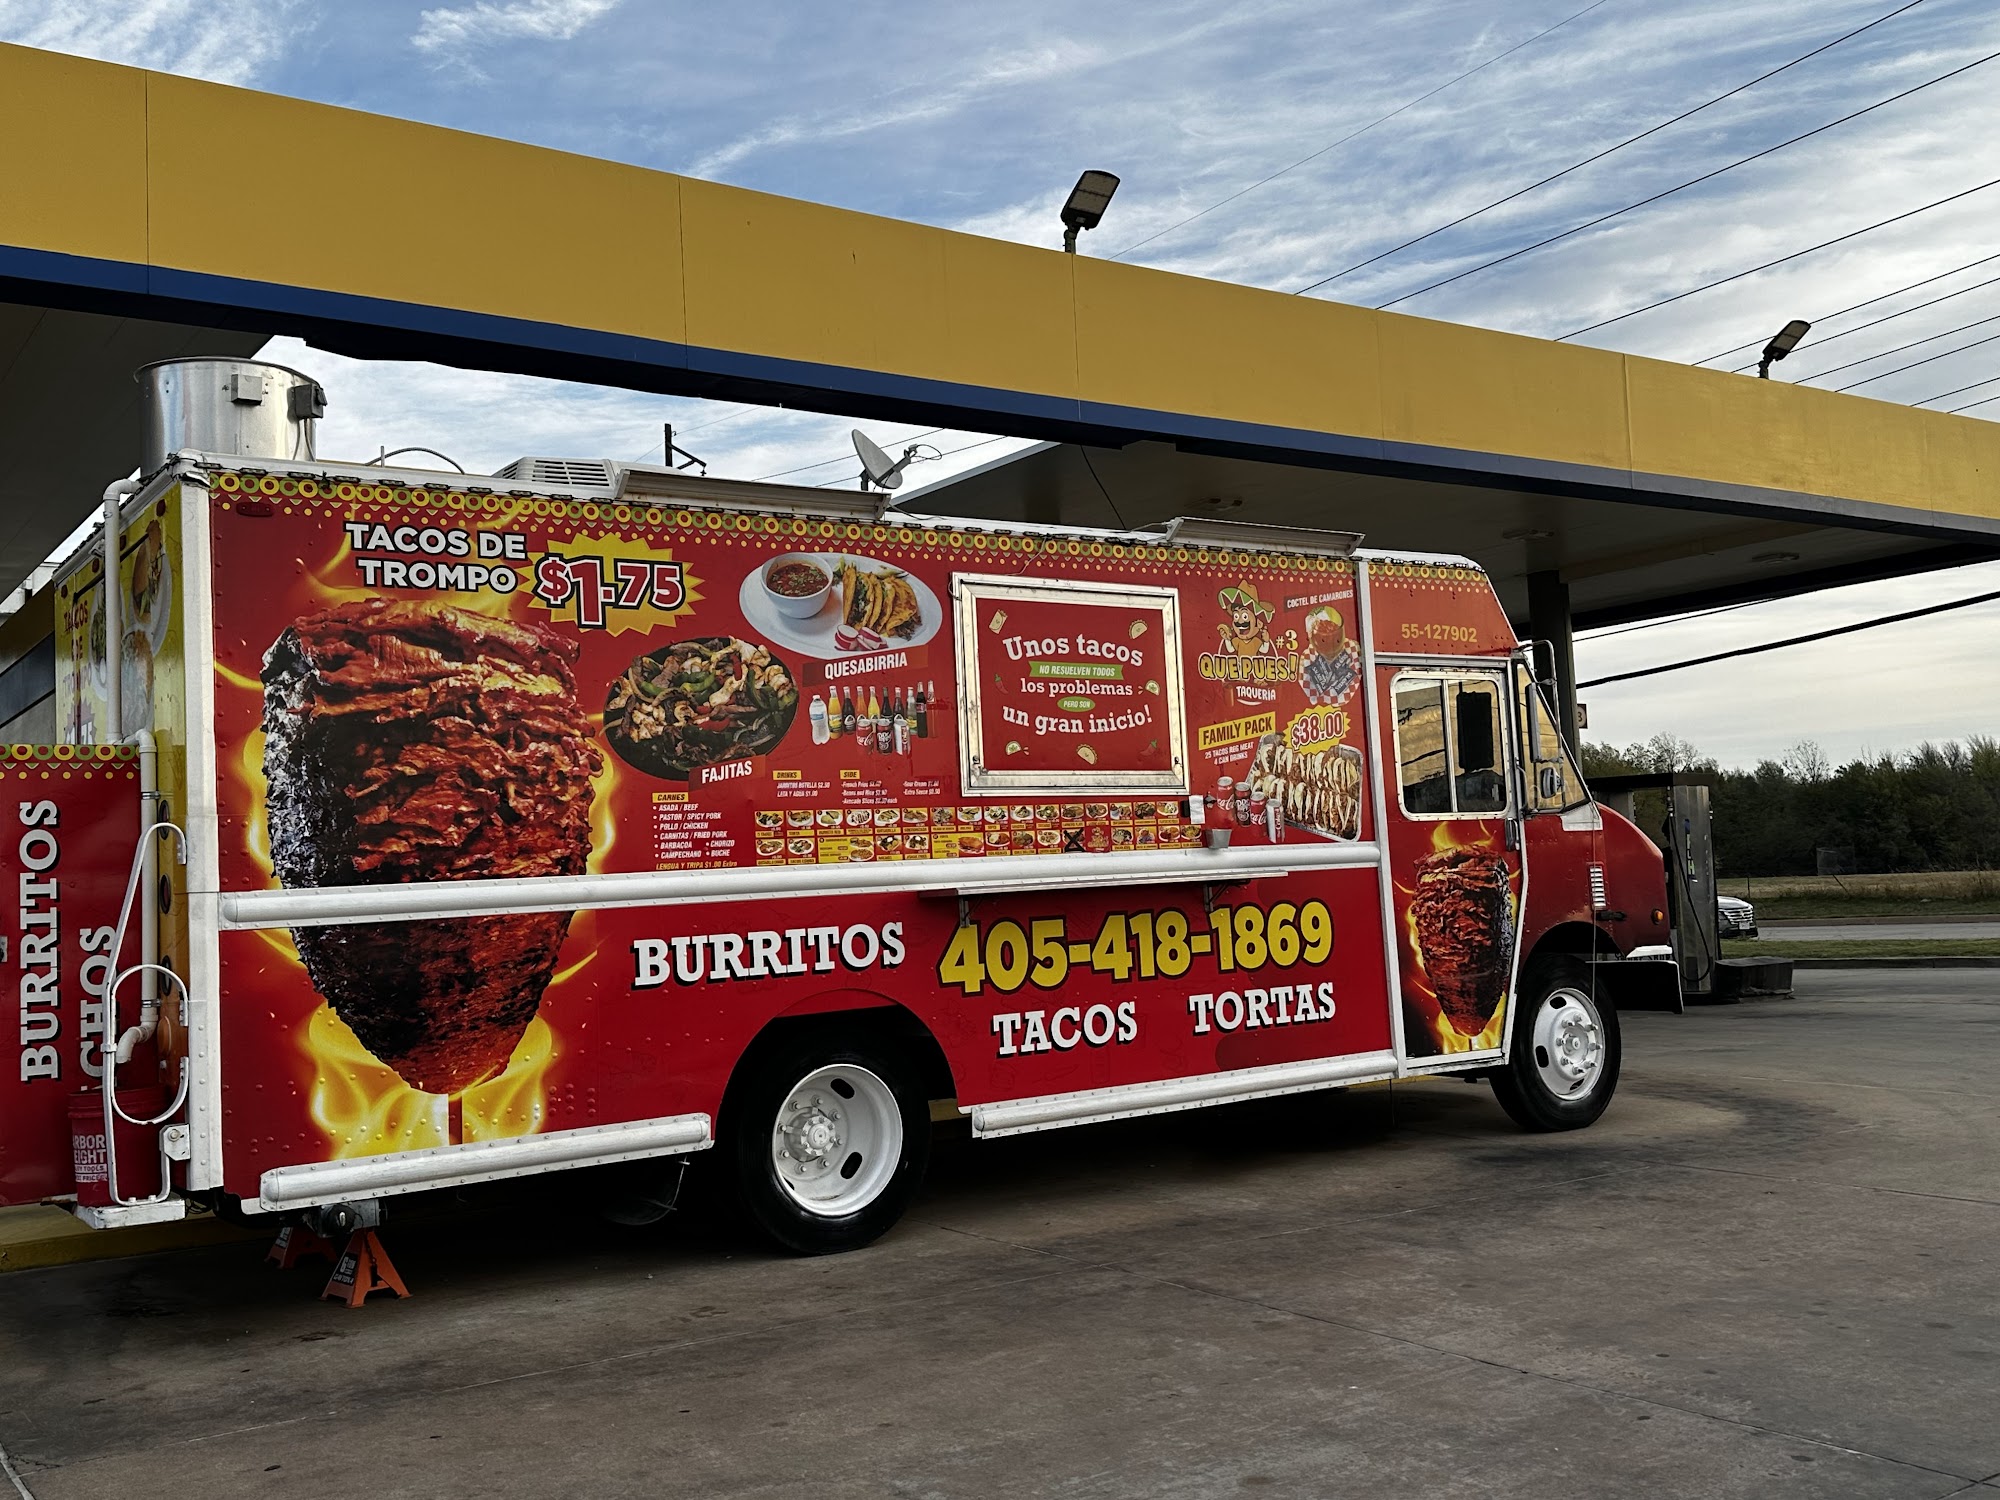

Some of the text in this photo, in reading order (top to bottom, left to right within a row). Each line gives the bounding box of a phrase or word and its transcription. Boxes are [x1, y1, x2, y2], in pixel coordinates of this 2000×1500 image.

[345, 523, 527, 560] TACOS DE
[357, 559, 518, 593] TROMPO
[537, 554, 685, 627] $1.75
[1286, 589, 1354, 609] COCTEL DE CAMARONES
[1275, 629, 1299, 651] #3
[1401, 623, 1478, 643] 55-127902
[1002, 633, 1144, 667] Unos tacos
[824, 652, 908, 680] QUESABIRRIA
[1039, 665, 1115, 677] NO RESUELVEN TODOS
[1020, 678, 1133, 698] los problemas
[1063, 700, 1091, 708] PERO SON
[1002, 704, 1153, 736] un gran inicio!
[1202, 716, 1273, 746] FAMILY PACK
[1291, 711, 1345, 750] $38.00
[1204, 751, 1212, 759] 25
[1212, 747, 1229, 758] TACOS
[701, 760, 753, 784] FAJITAS
[776, 771, 798, 779] DRINKS
[657, 793, 686, 802] CARNES
[683, 803, 699, 811] BEEF
[659, 813, 682, 821] PASTOR
[660, 832, 689, 840] CARNITAS
[19, 800, 59, 1083] BURRITOS
[634, 900, 1332, 994] BURRITOS 405-418-1869
[992, 982, 1336, 1056] TACOS TORTAS
